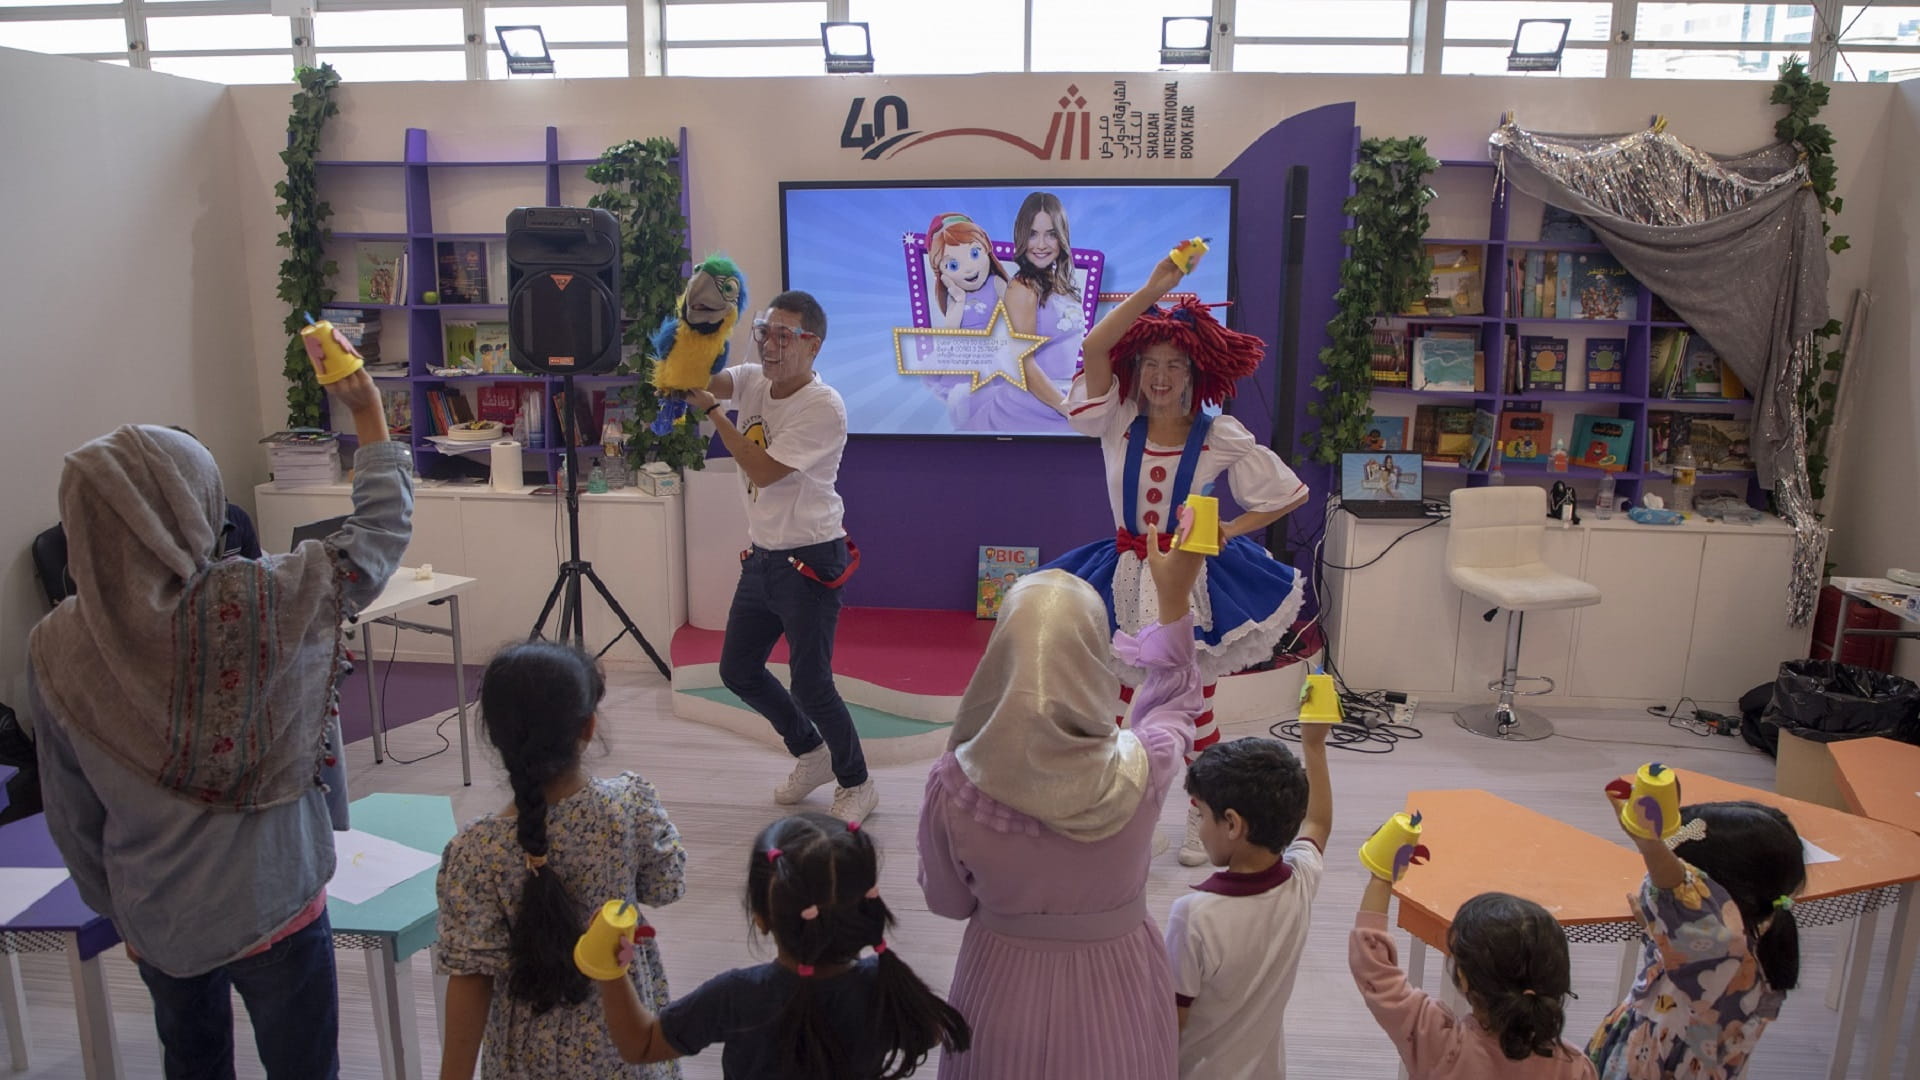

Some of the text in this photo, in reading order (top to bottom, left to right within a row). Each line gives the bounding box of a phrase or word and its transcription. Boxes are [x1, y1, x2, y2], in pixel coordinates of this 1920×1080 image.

[1112, 80, 1131, 119] الشارقة
[1163, 80, 1179, 159] INTERNATIONAL
[1146, 113, 1160, 159] SHARJAH
[1180, 105, 1195, 159] BOOK FAIR
[995, 549, 1025, 564] BIG
